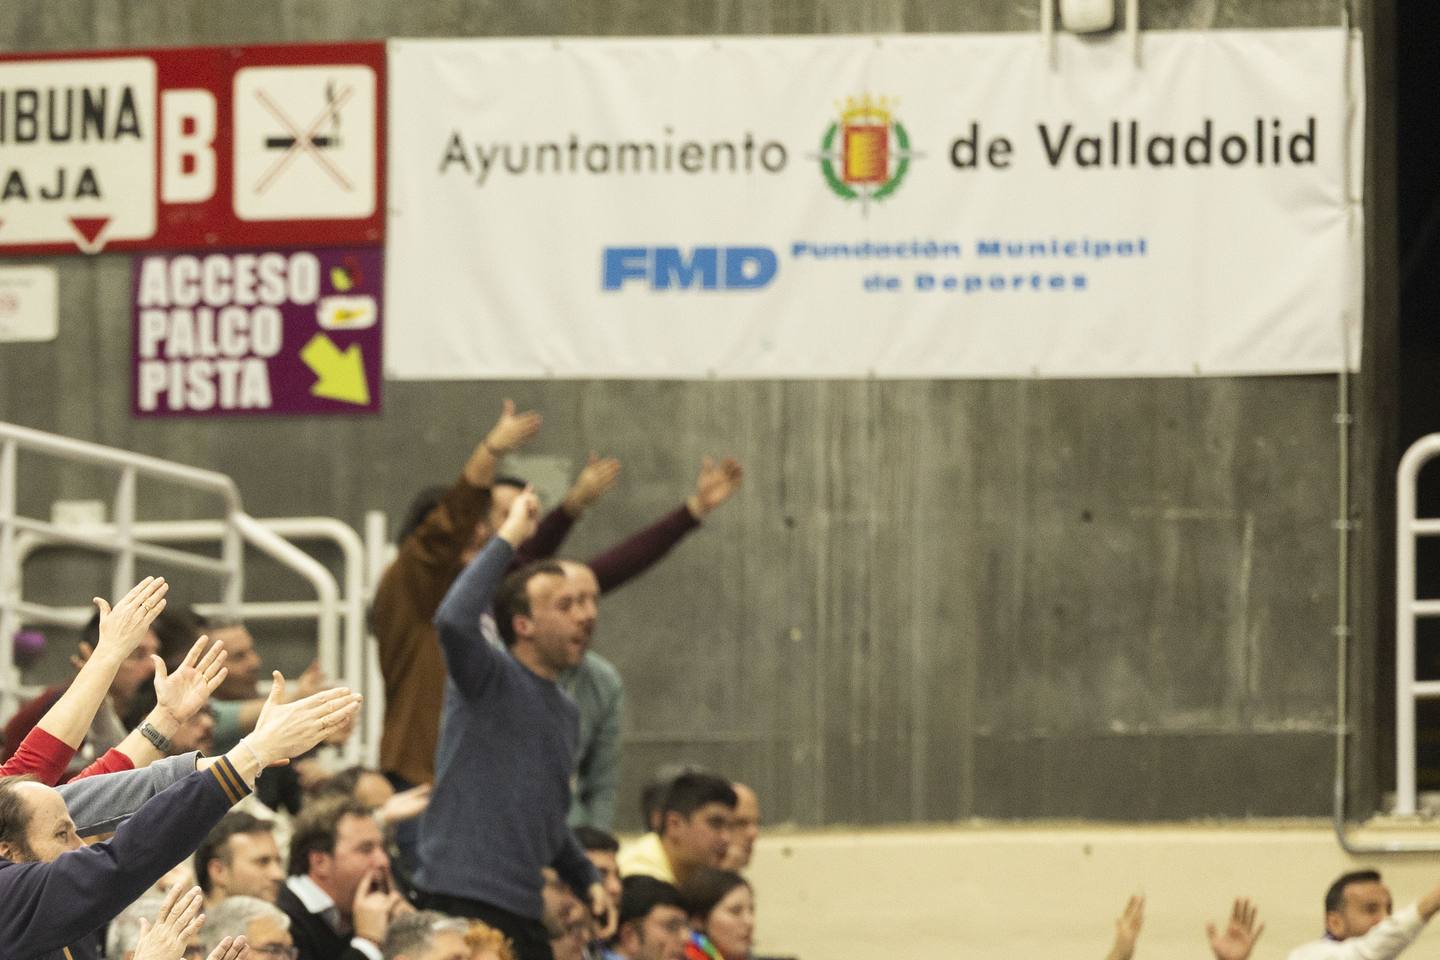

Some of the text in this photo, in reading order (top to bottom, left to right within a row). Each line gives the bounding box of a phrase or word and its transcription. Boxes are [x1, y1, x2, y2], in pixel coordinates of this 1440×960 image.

[160, 87, 218, 204] B
[437, 125, 790, 189] Ayuntamiento
[948, 114, 1318, 171] de Valladolid
[138, 252, 322, 306] ACCESO
[602, 245, 780, 292] FMD
[862, 271, 1088, 296] de Deportes
[138, 305, 284, 360] PALCO
[138, 357, 273, 412] PISTA
